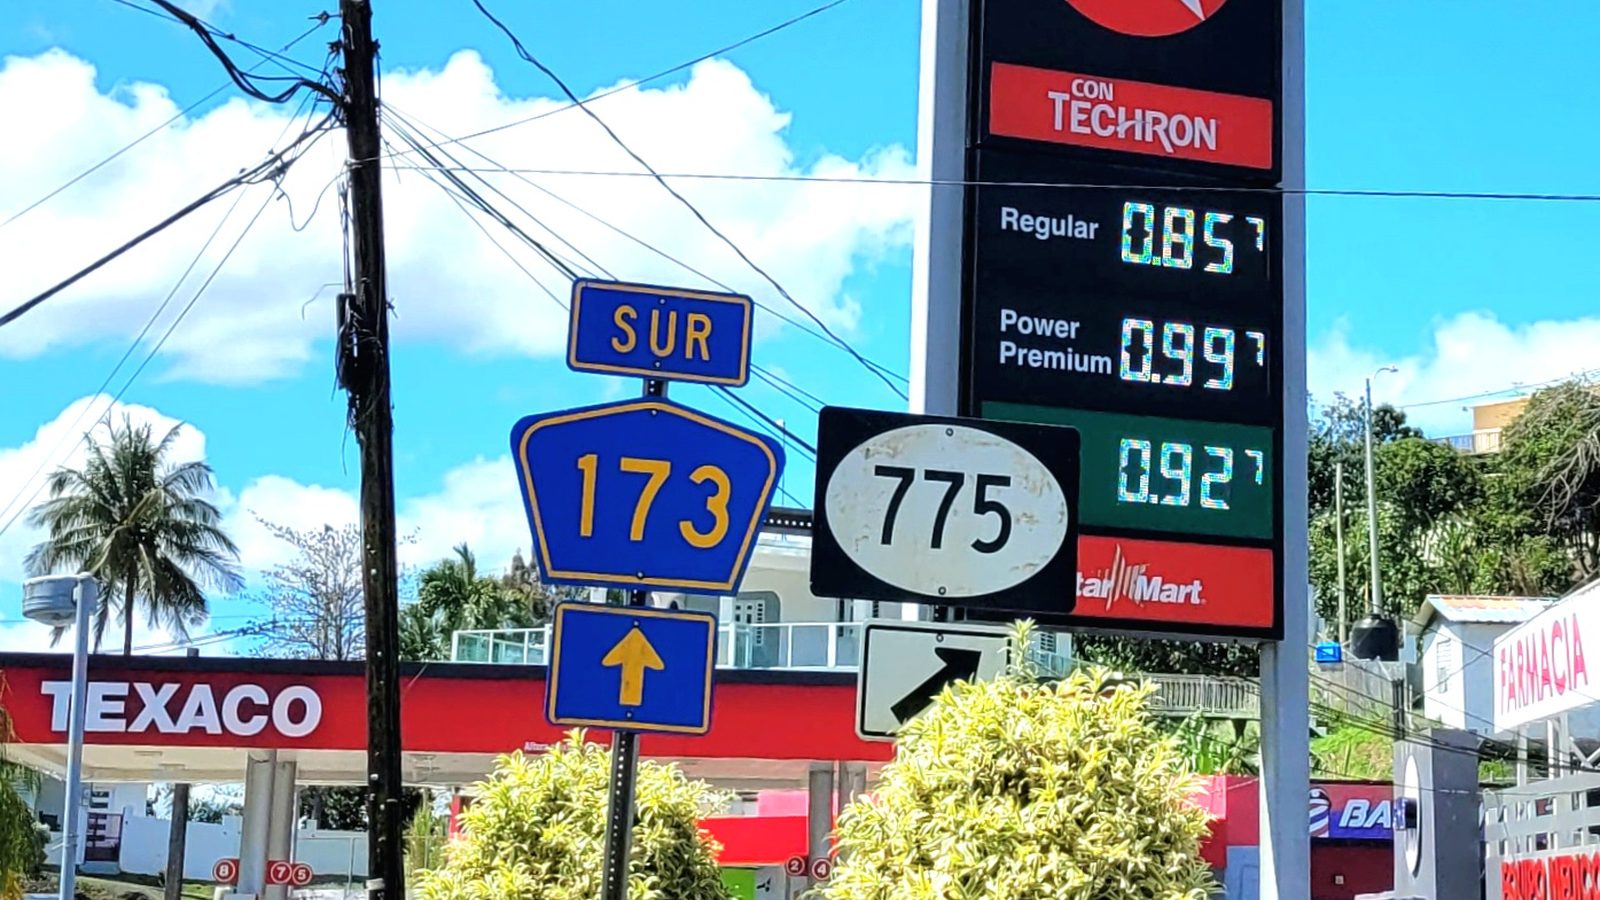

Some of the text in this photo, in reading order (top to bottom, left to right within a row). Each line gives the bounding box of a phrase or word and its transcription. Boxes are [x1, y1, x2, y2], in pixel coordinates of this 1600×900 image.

[1071, 79, 1114, 101] CON
[1048, 91, 1217, 153] TECHRON
[1000, 206, 1099, 240] Regular
[611, 304, 712, 361] SUR
[1000, 309, 1080, 339] Power
[999, 341, 1112, 375] Premium
[577, 453, 732, 549] 173
[874, 464, 1012, 554] 775
[1076, 572, 1202, 604] tar Mart
[1501, 612, 1589, 715] FARMACIA
[41, 680, 322, 737] TEXACO
[218, 864, 230, 877] 8
[276, 866, 286, 879] 7
[297, 869, 307, 881] 5
[790, 861, 800, 871] 2
[817, 864, 827, 875] 4
